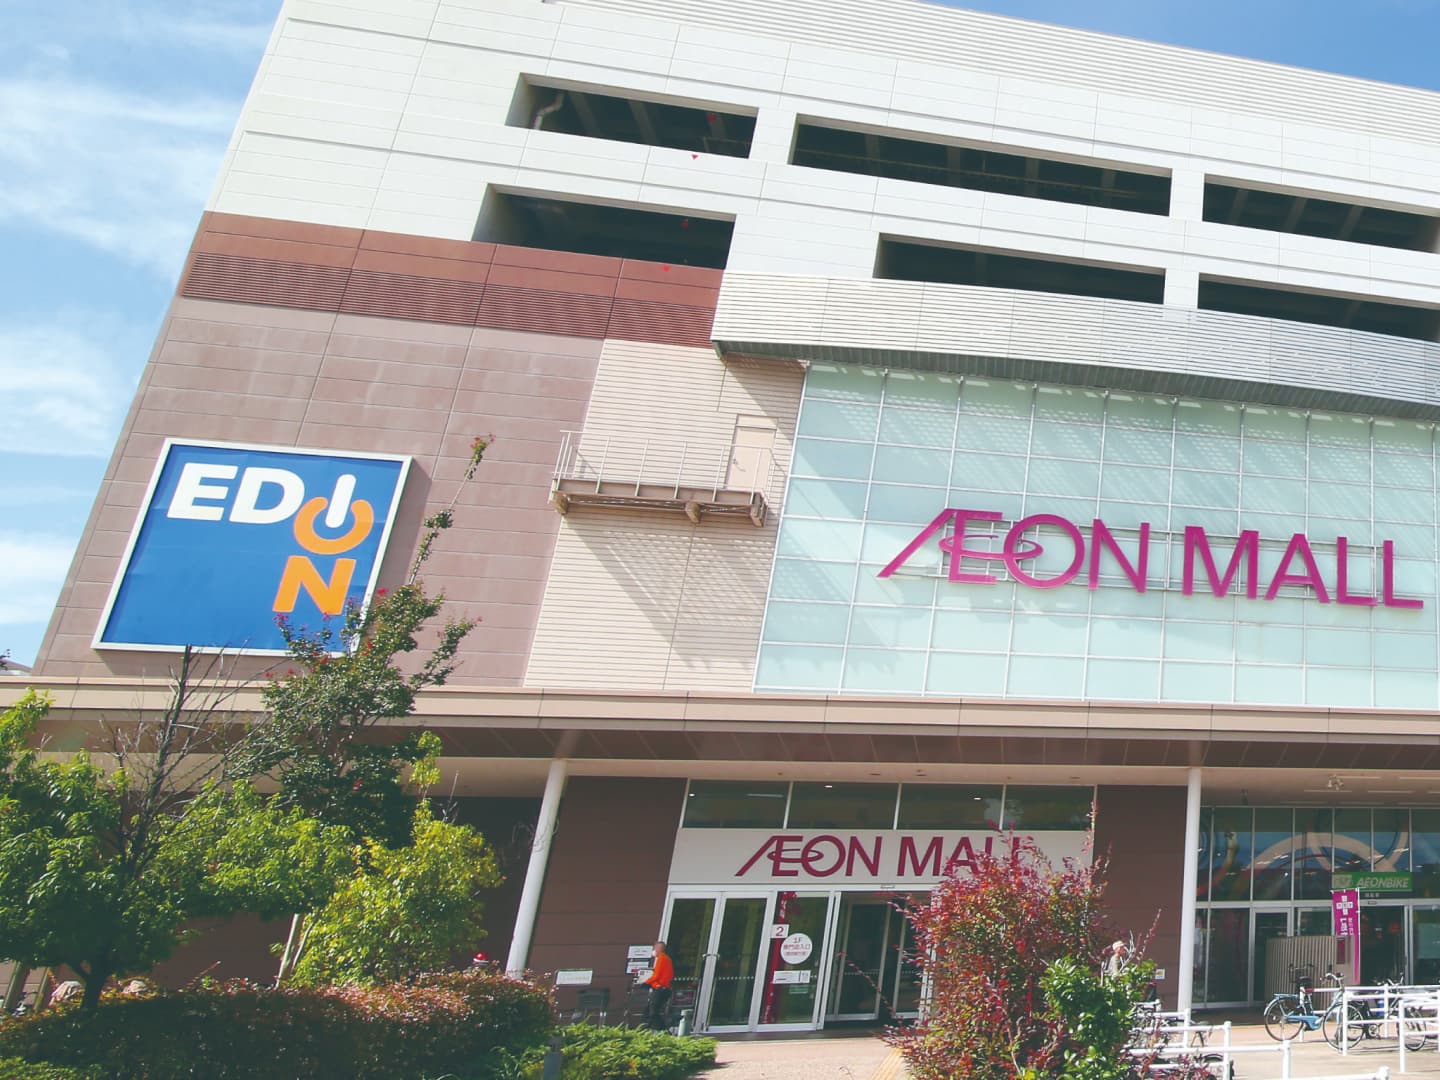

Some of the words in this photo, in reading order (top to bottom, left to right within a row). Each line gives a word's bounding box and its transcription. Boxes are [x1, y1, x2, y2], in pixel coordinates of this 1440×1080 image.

[1181, 525, 1424, 609] MALL
[1357, 877, 1409, 888] AEONBIKE
[775, 926, 785, 937] 2
